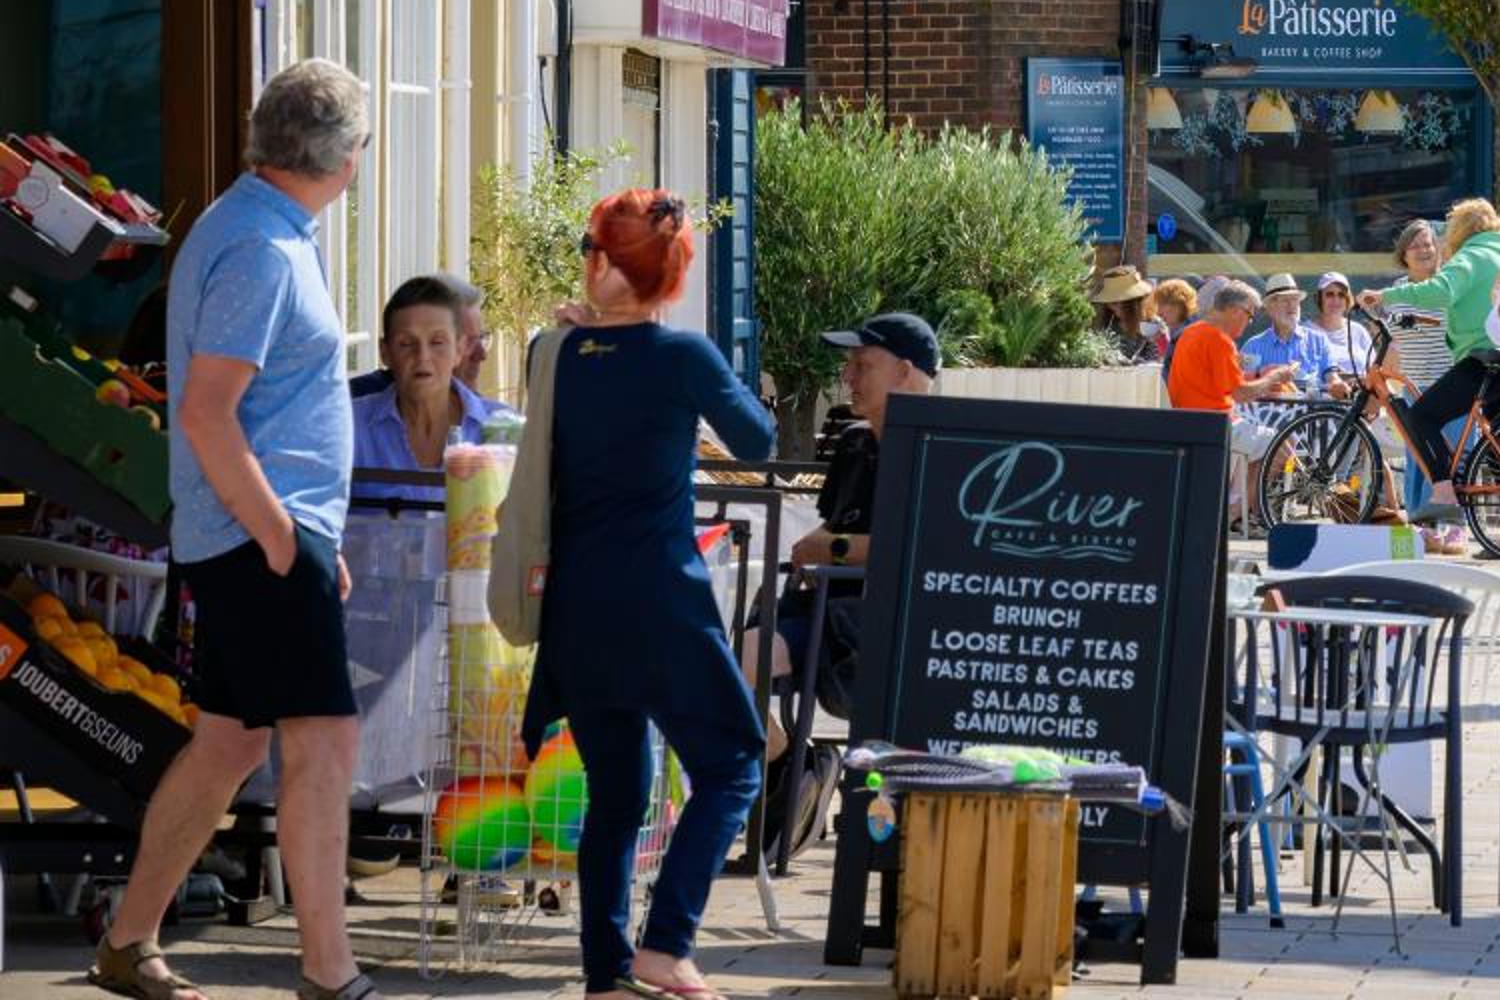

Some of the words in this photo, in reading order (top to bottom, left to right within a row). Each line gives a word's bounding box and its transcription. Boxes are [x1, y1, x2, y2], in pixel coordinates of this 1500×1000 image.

[1313, 47, 1351, 58] COFFEE
[1356, 47, 1383, 59] SHOP
[959, 441, 1144, 547] River
[924, 572, 1044, 597] SPECIALTY
[1051, 580, 1157, 604] COFFEES
[993, 605, 1081, 628] BRUNCH
[931, 629, 1011, 654] LOOSE
[1019, 635, 1074, 657] LEAF
[1083, 639, 1138, 661] TEAS
[927, 658, 1028, 683] PASTRIES
[1036, 665, 1050, 685] &
[1057, 667, 1135, 689] CAKES
[972, 689, 1059, 713] SALADS
[1068, 695, 1083, 714] &
[954, 711, 1099, 738] SANDWICHES
